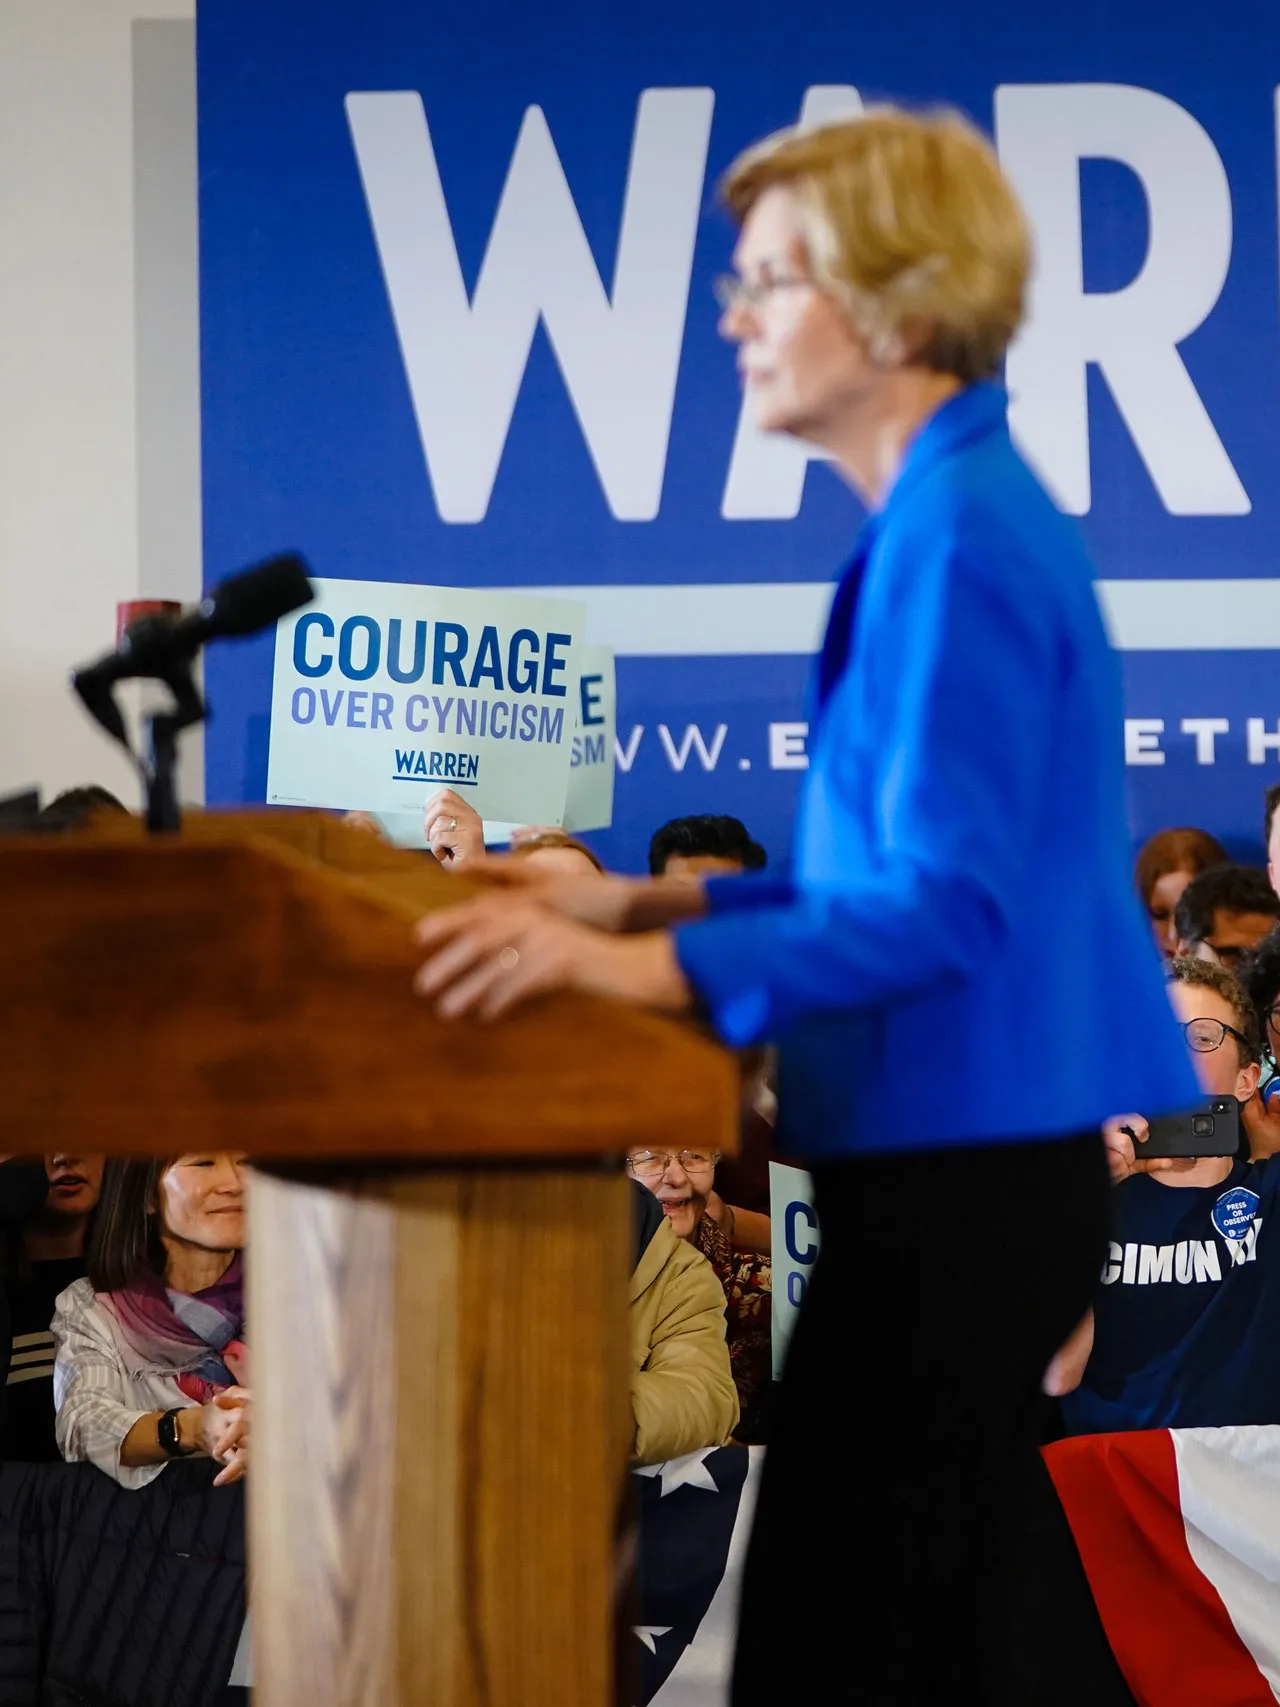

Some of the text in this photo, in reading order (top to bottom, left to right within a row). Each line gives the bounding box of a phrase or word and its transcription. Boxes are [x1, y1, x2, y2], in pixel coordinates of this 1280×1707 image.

[293, 612, 571, 696] COURAGE
[291, 687, 394, 730] OVER
[405, 694, 564, 744] CYNICISM
[395, 749, 479, 779] WARREN
[1226, 1201, 1247, 1211] PRESS
[1232, 1209, 1243, 1218] OR
[1100, 1239, 1222, 1285] CIMUN
